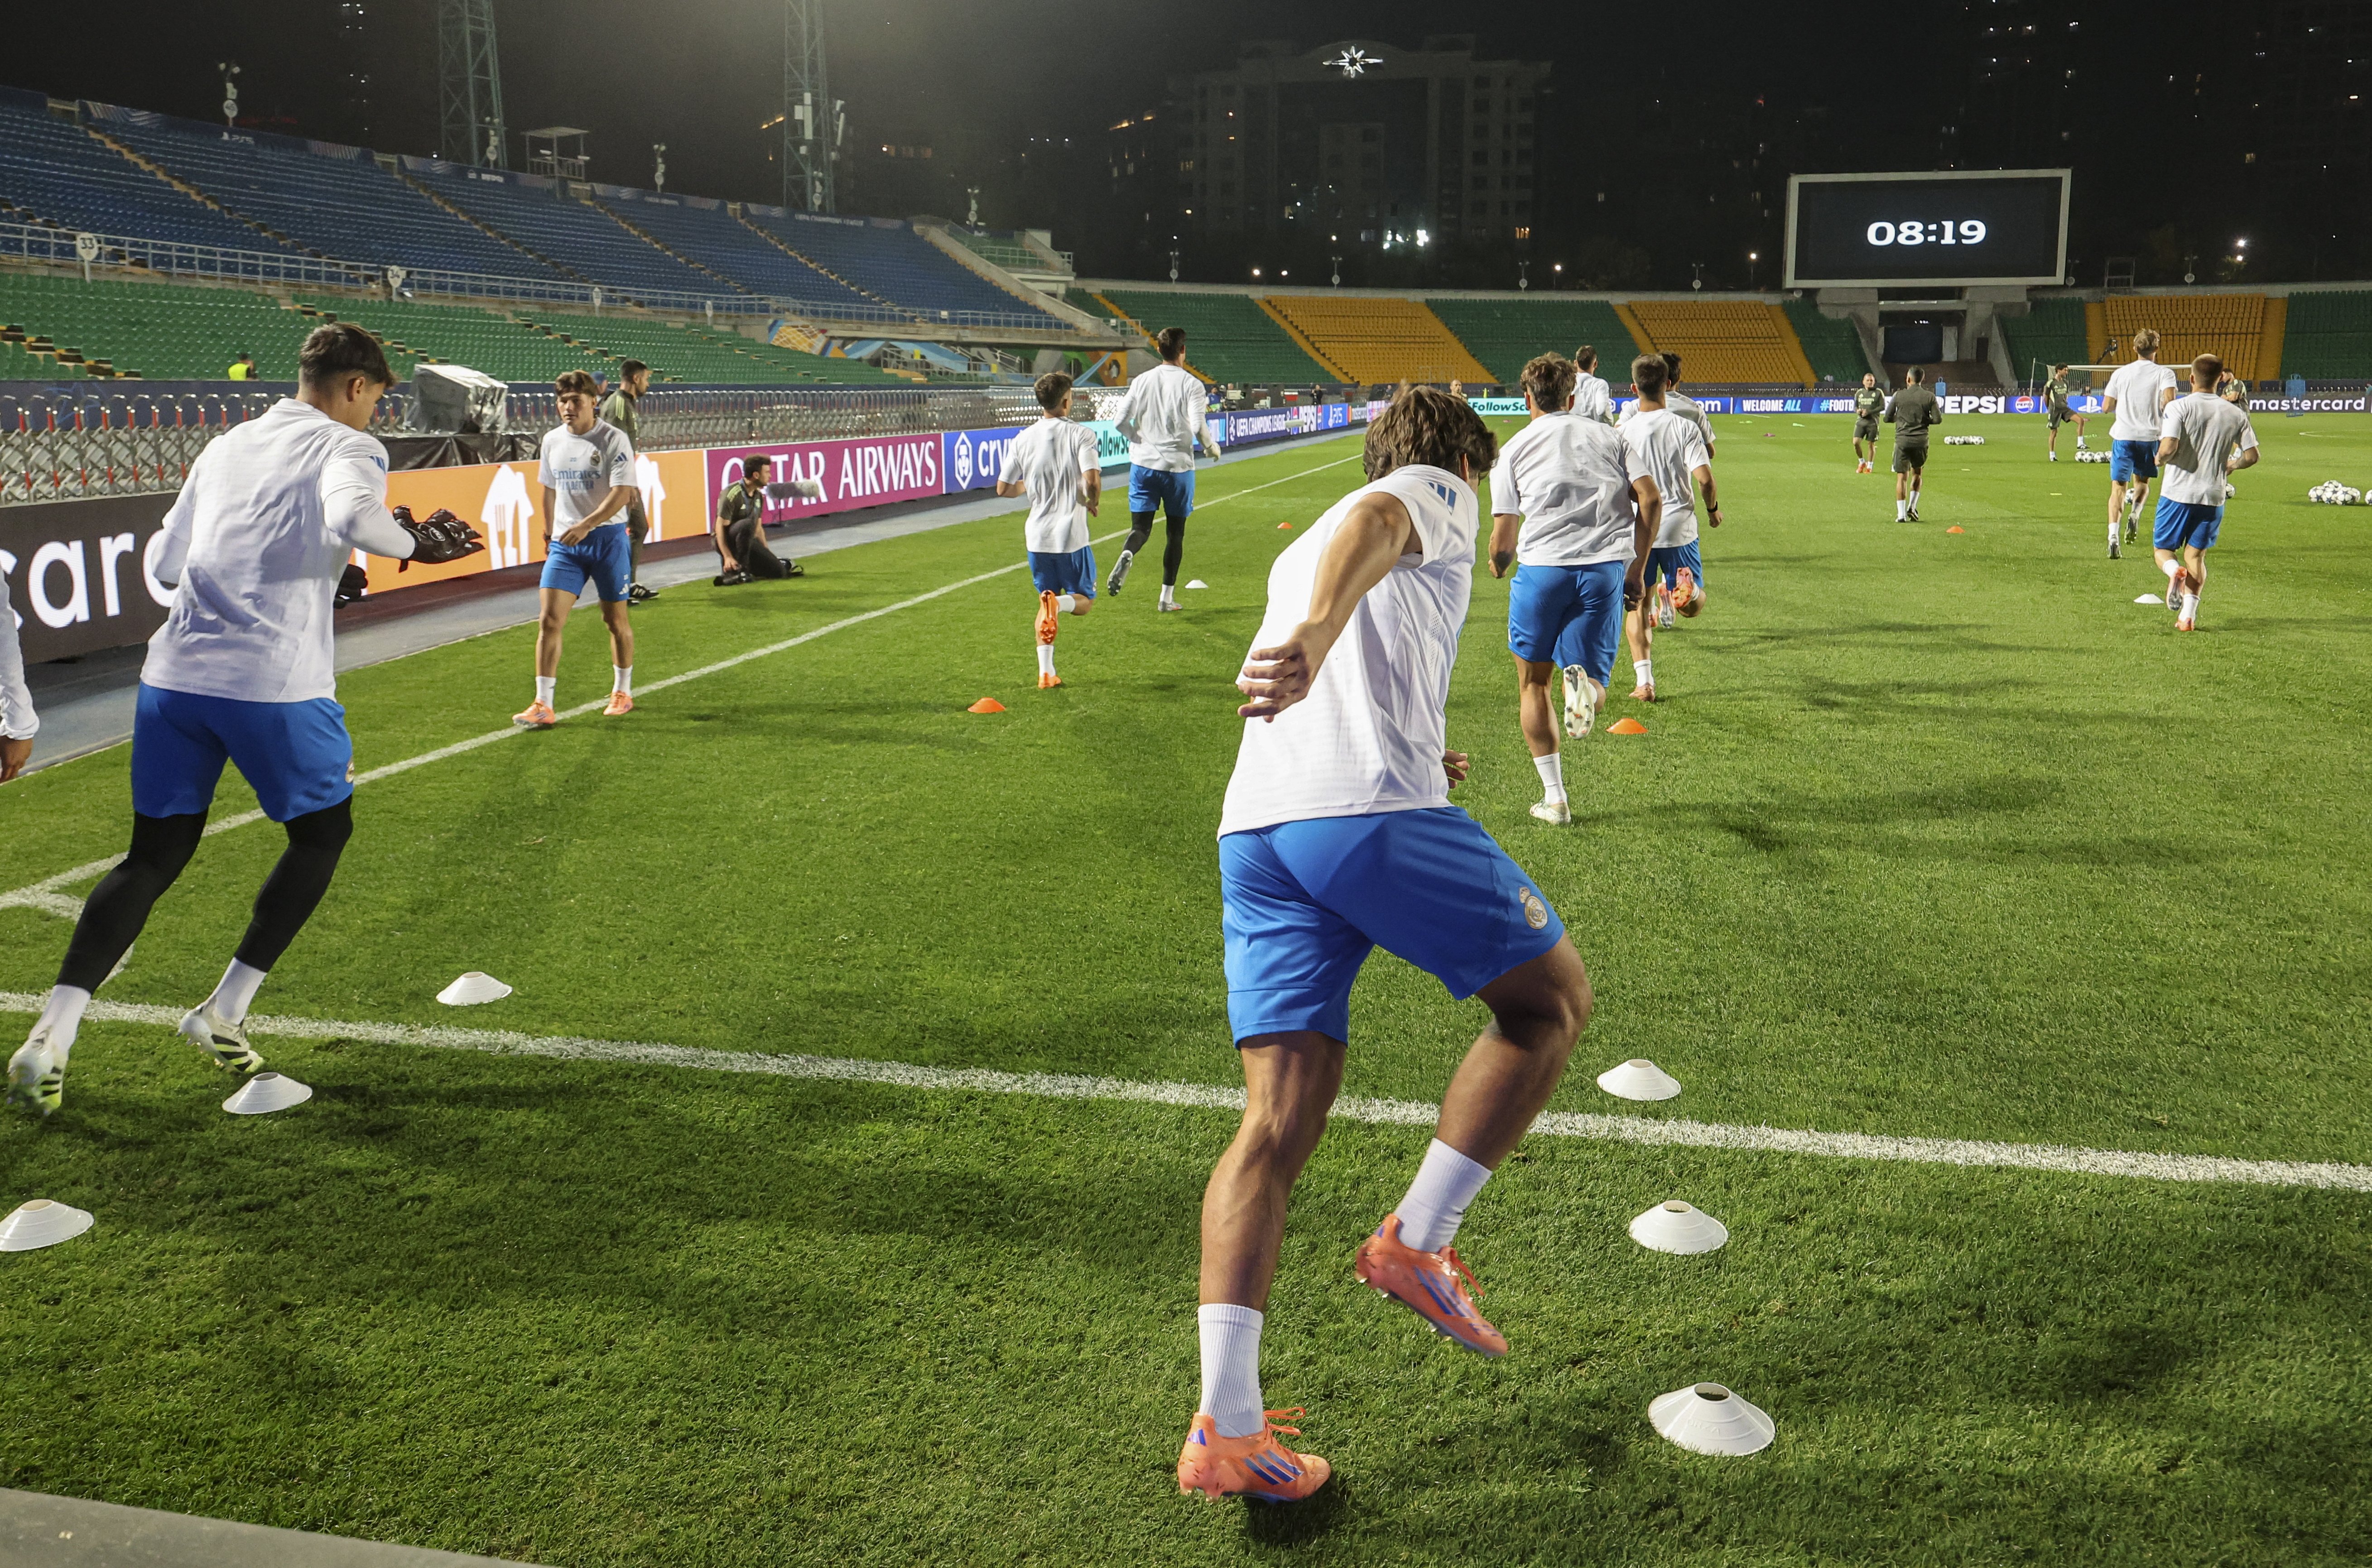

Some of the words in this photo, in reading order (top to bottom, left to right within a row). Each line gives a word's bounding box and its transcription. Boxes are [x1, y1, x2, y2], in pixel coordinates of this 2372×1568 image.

[1867, 220, 1987, 246] 08:19
[80, 237, 94, 249] 33
[1742, 399, 1783, 412] WELCOME
[1784, 399, 1801, 411] ALL
[1820, 399, 1855, 412] #FOOTB
[2249, 397, 2366, 410] mastercard
[838, 440, 937, 500] AIRWAYS
[0, 529, 181, 630] ar
